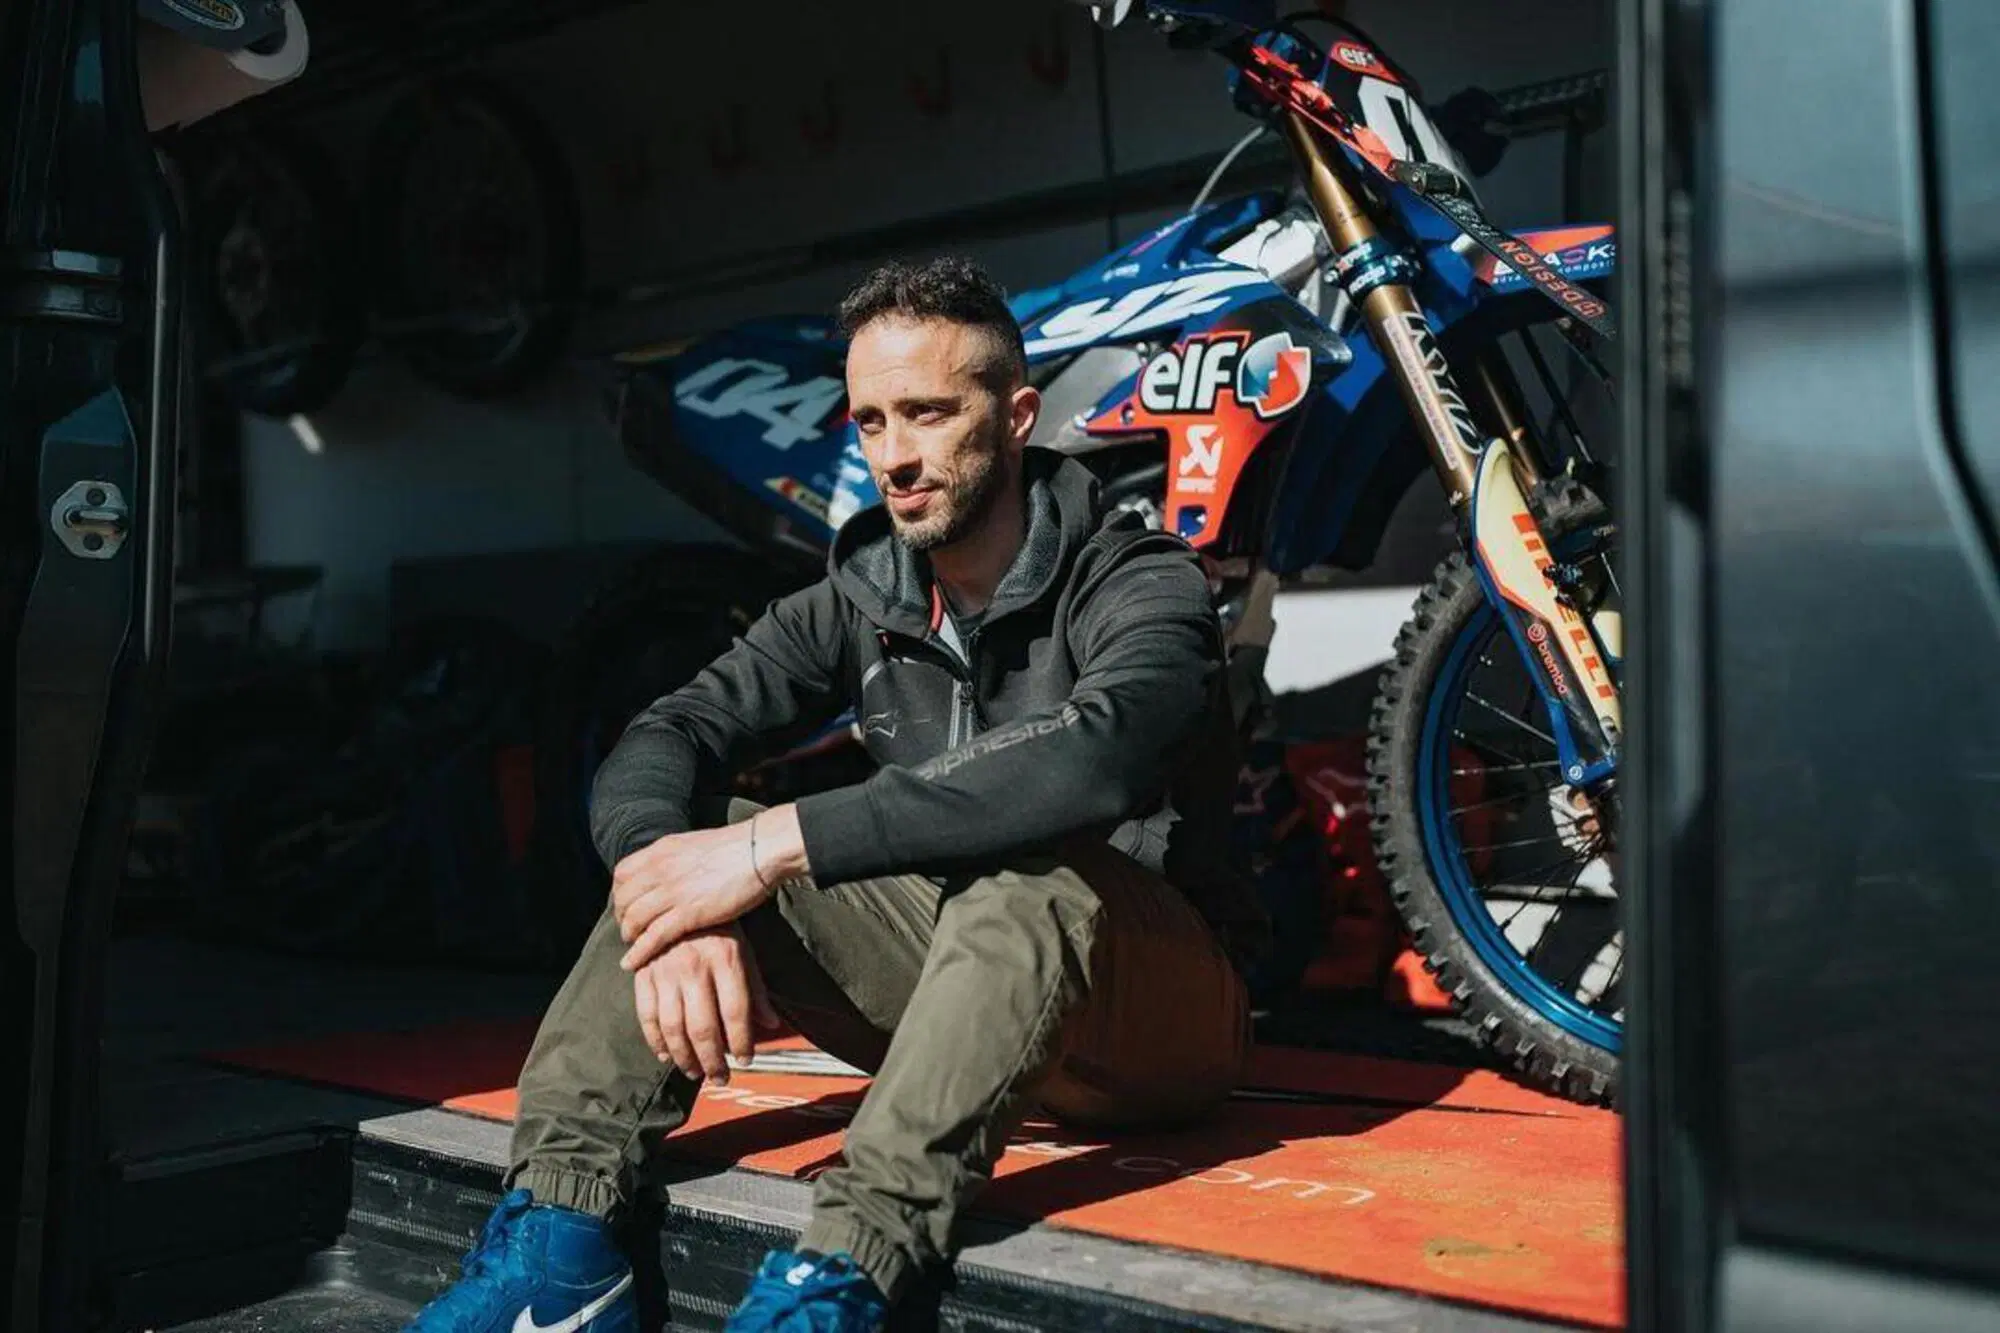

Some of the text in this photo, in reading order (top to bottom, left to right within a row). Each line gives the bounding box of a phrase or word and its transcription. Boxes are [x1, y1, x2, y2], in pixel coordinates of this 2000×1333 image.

[673, 356, 846, 452] 04
[1140, 341, 1239, 411] elf
[1538, 641, 1568, 695] brembo
